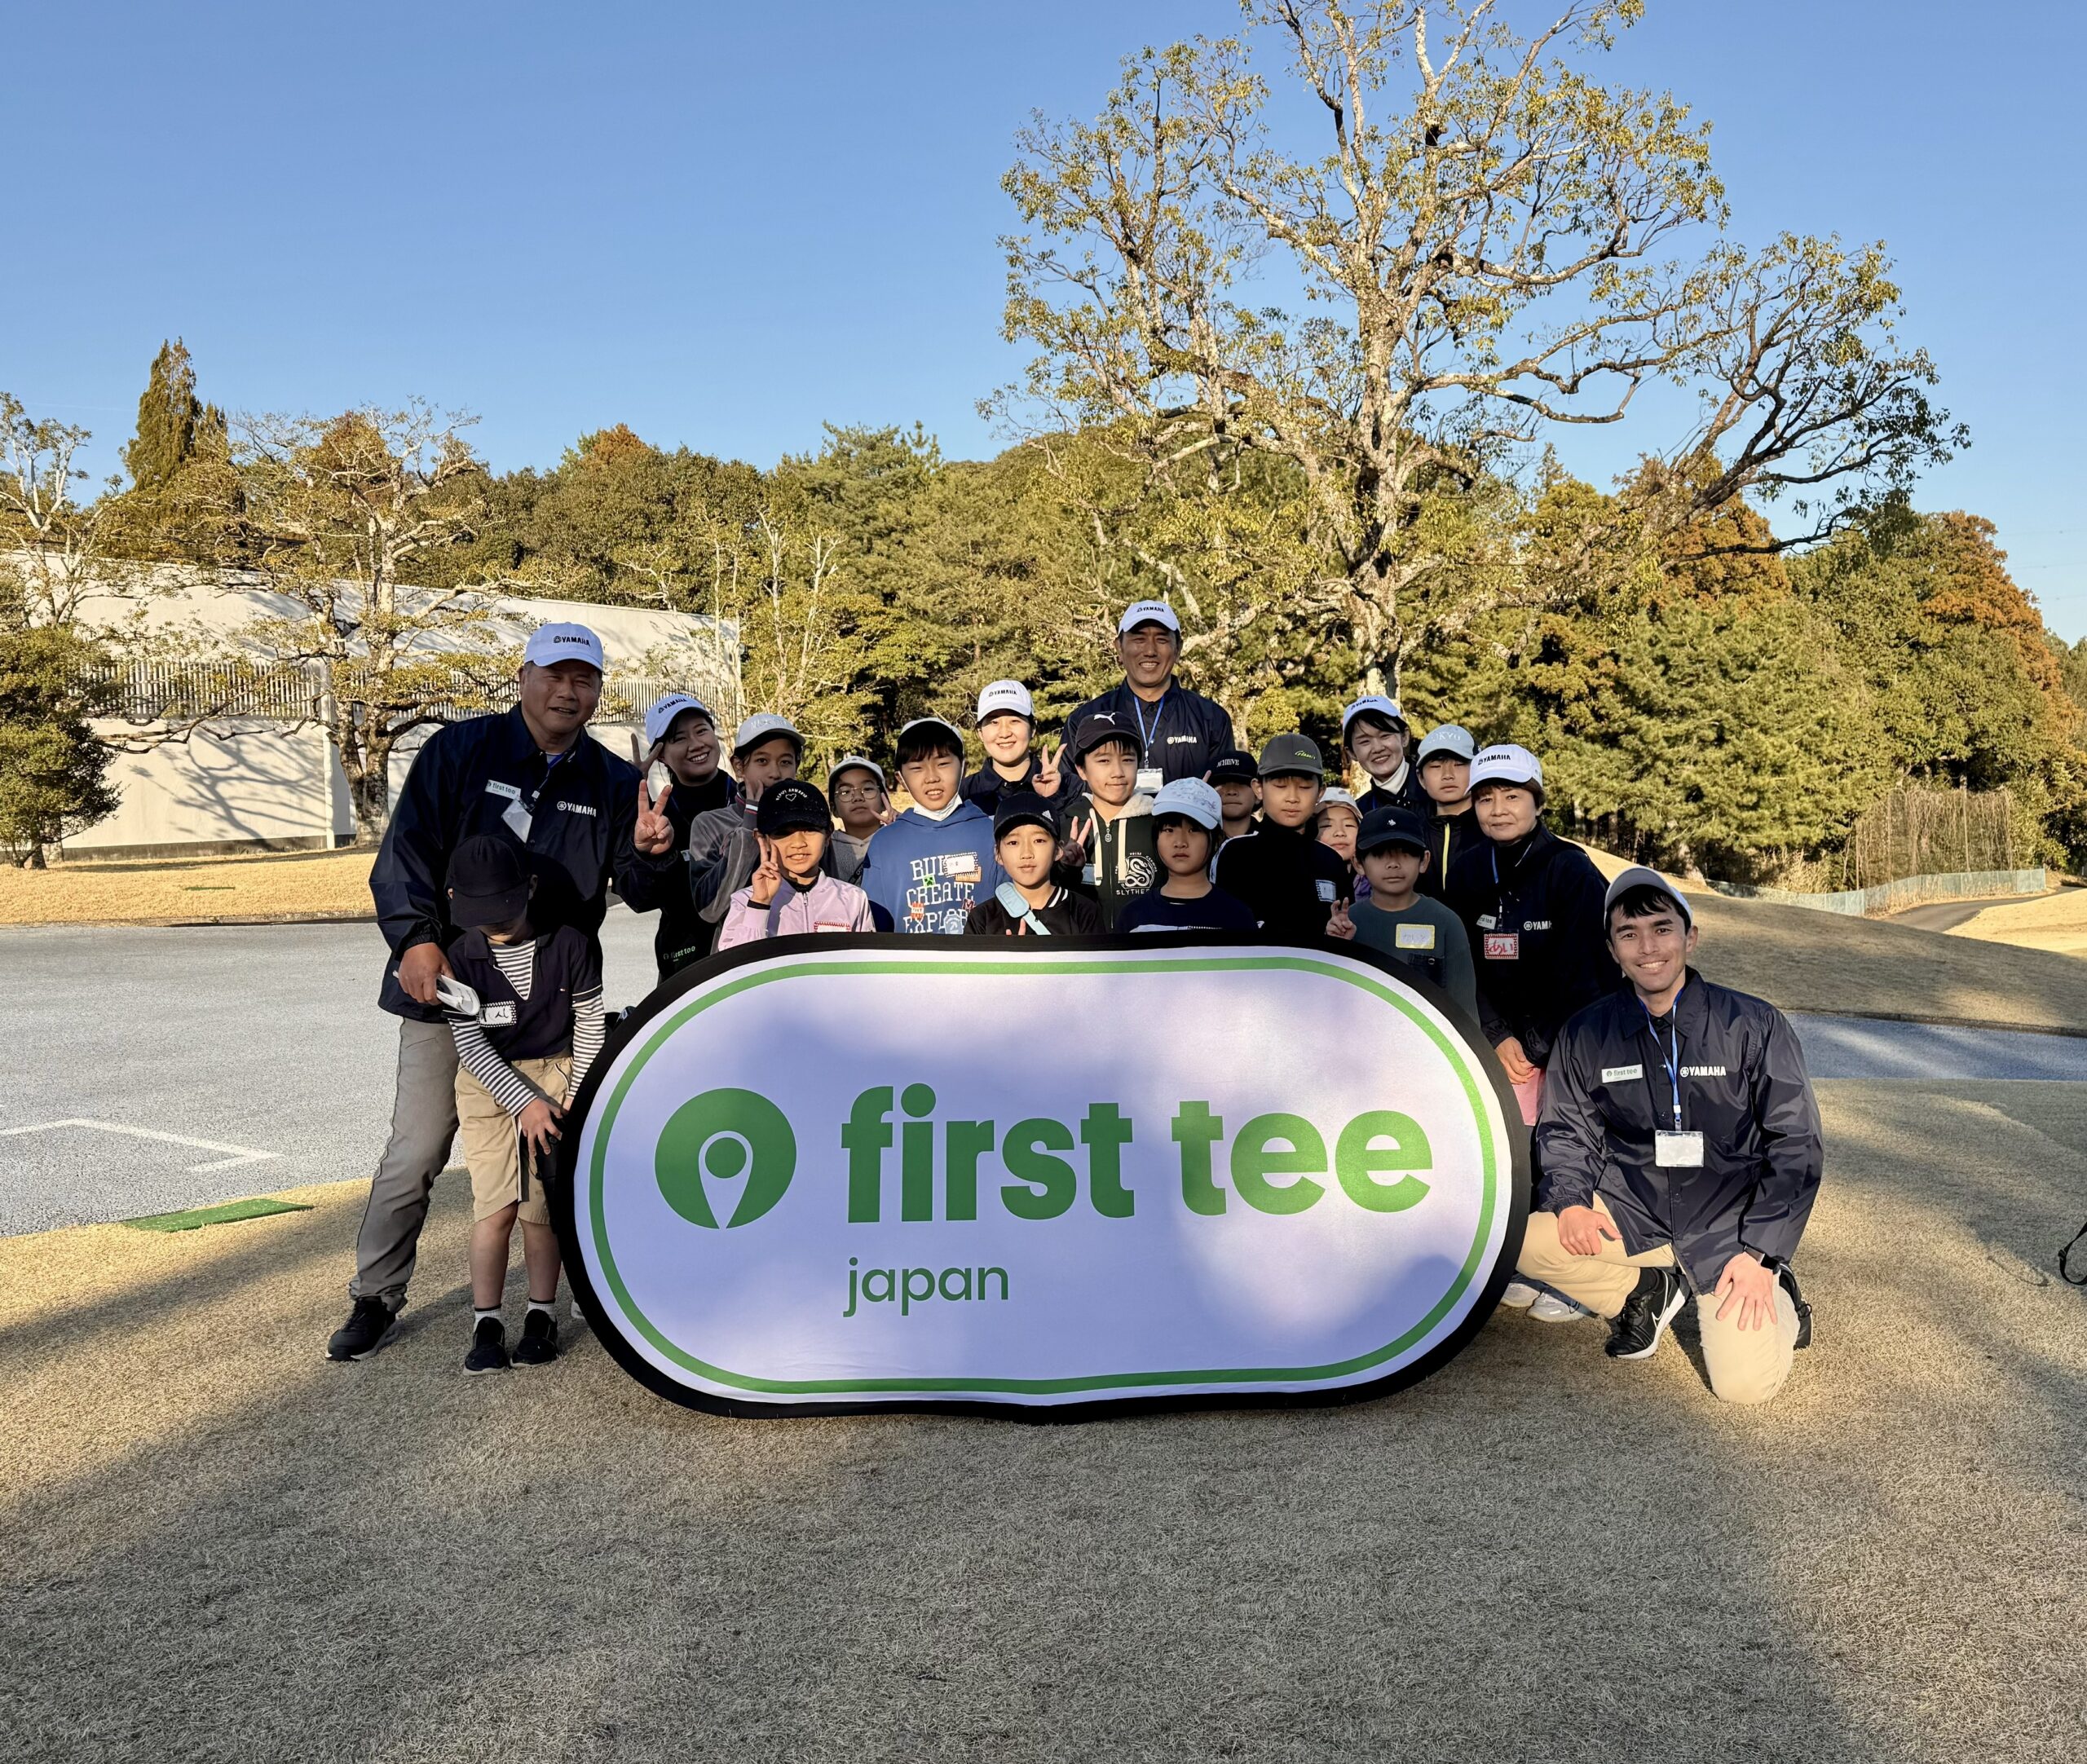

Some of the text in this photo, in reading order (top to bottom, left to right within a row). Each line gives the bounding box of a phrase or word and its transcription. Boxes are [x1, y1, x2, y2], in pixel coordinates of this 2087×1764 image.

[562, 636, 590, 646] YAMAHA
[663, 699, 687, 709] YAMAHA
[1484, 754, 1511, 763] YAMAHA
[567, 802, 597, 817] YAMAHA
[906, 881, 974, 908] CREATE
[1689, 1066, 1727, 1077] YAMAHA
[841, 1082, 1434, 1224] first tee
[842, 1256, 1010, 1318] japan
